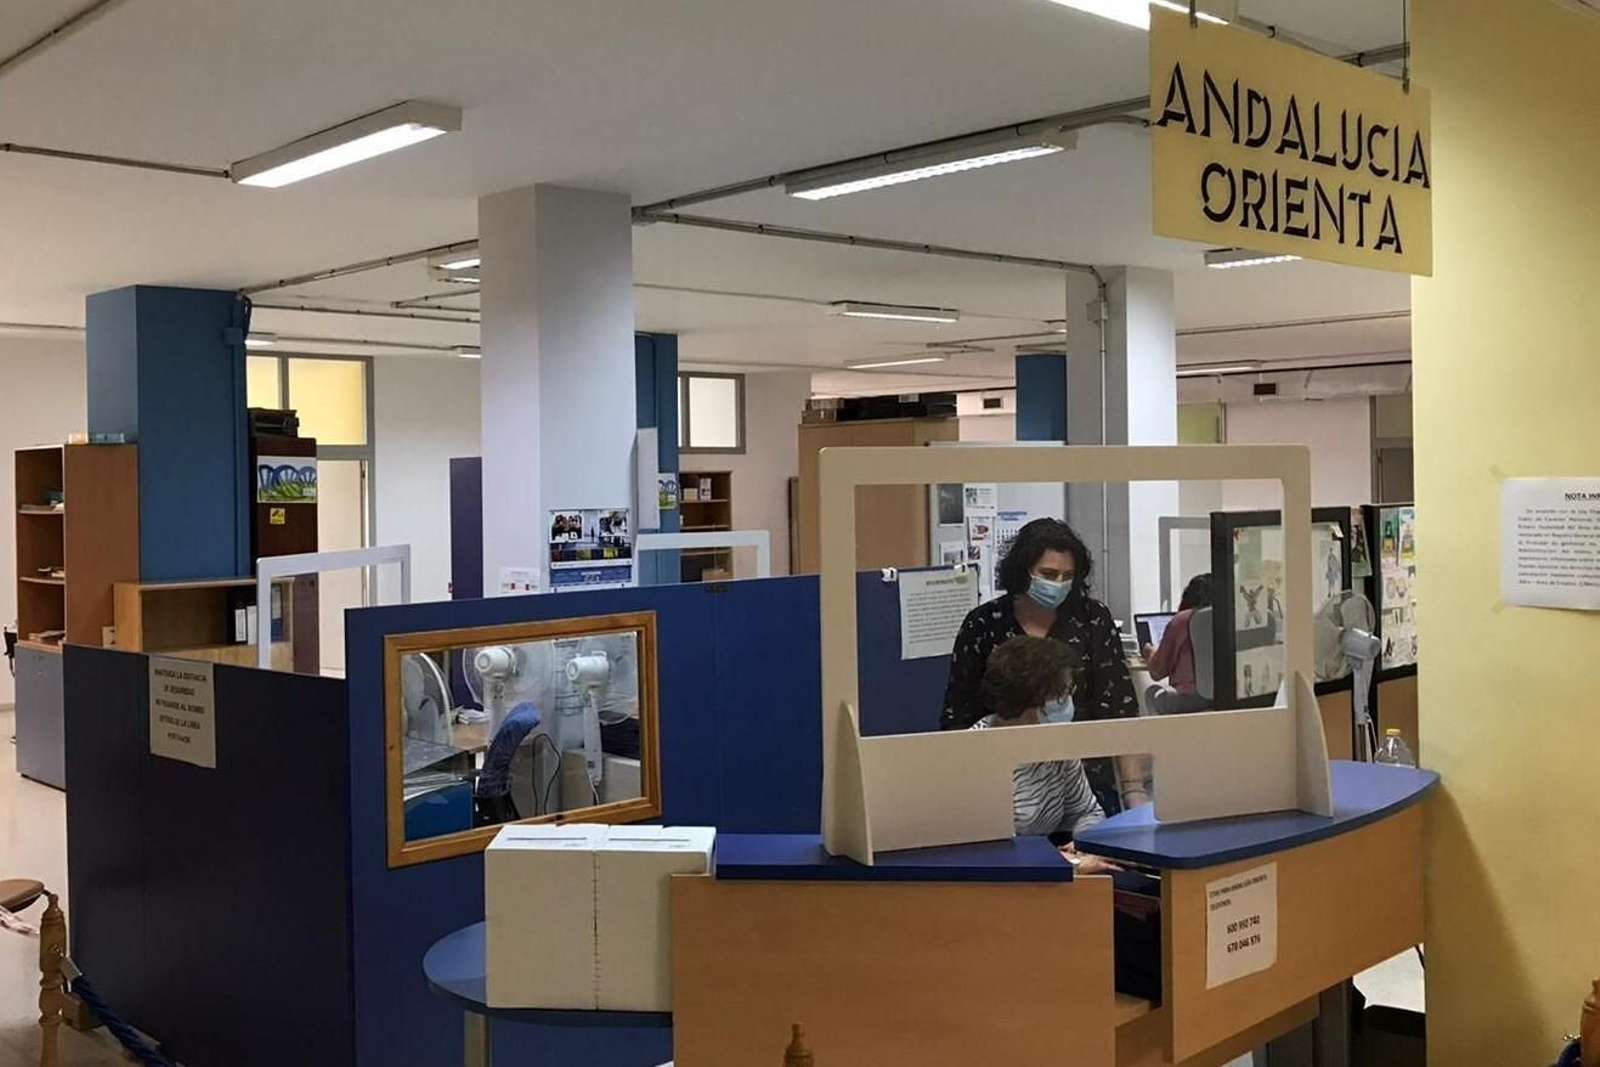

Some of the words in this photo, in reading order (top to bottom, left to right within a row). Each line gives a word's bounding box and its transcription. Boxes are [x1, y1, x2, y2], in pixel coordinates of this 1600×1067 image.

[1154, 60, 1431, 190] ANDALUCIA
[1201, 162, 1403, 254] ORIENTA
[1564, 492, 1586, 501] NOTA
